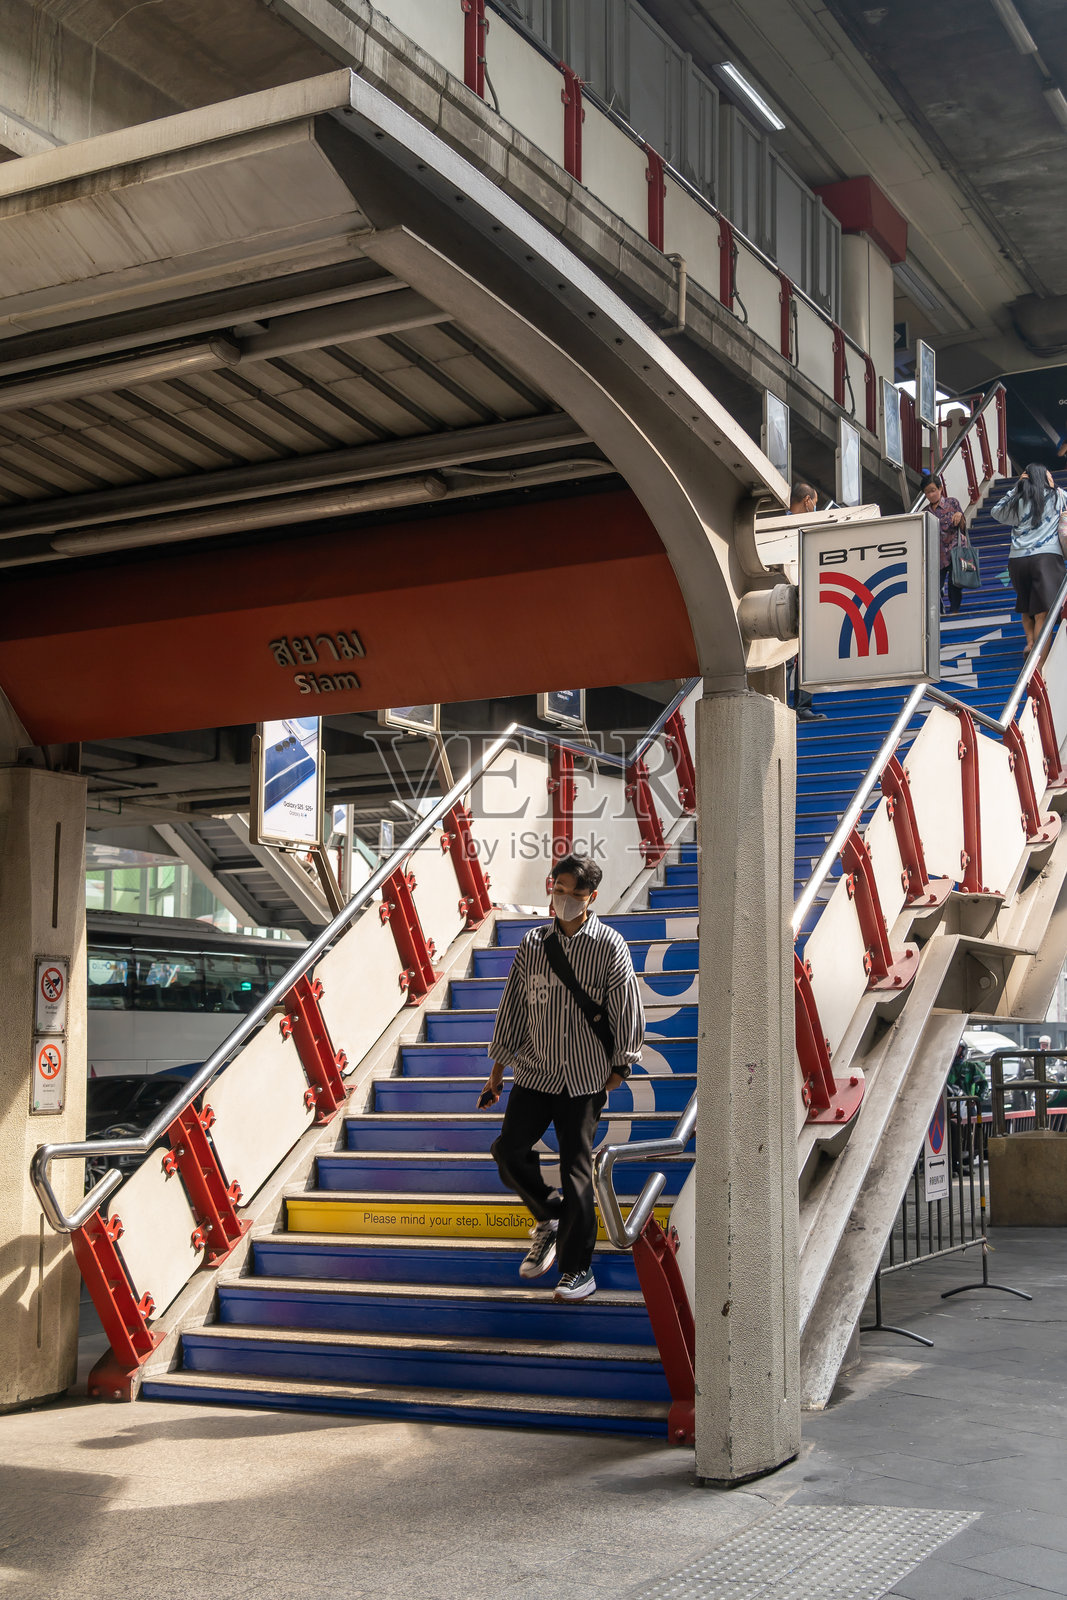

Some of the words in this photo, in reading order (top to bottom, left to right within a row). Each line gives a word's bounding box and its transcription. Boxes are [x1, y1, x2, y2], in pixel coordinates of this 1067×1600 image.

[819, 541, 907, 566] BTS
[268, 629, 366, 667] สยาม
[293, 671, 361, 694] Siam
[283, 801, 297, 810] Galaxy
[363, 1212, 396, 1224] Please
[400, 1214, 425, 1225] mind
[429, 1216, 452, 1228] your
[455, 1215, 482, 1228] step.
